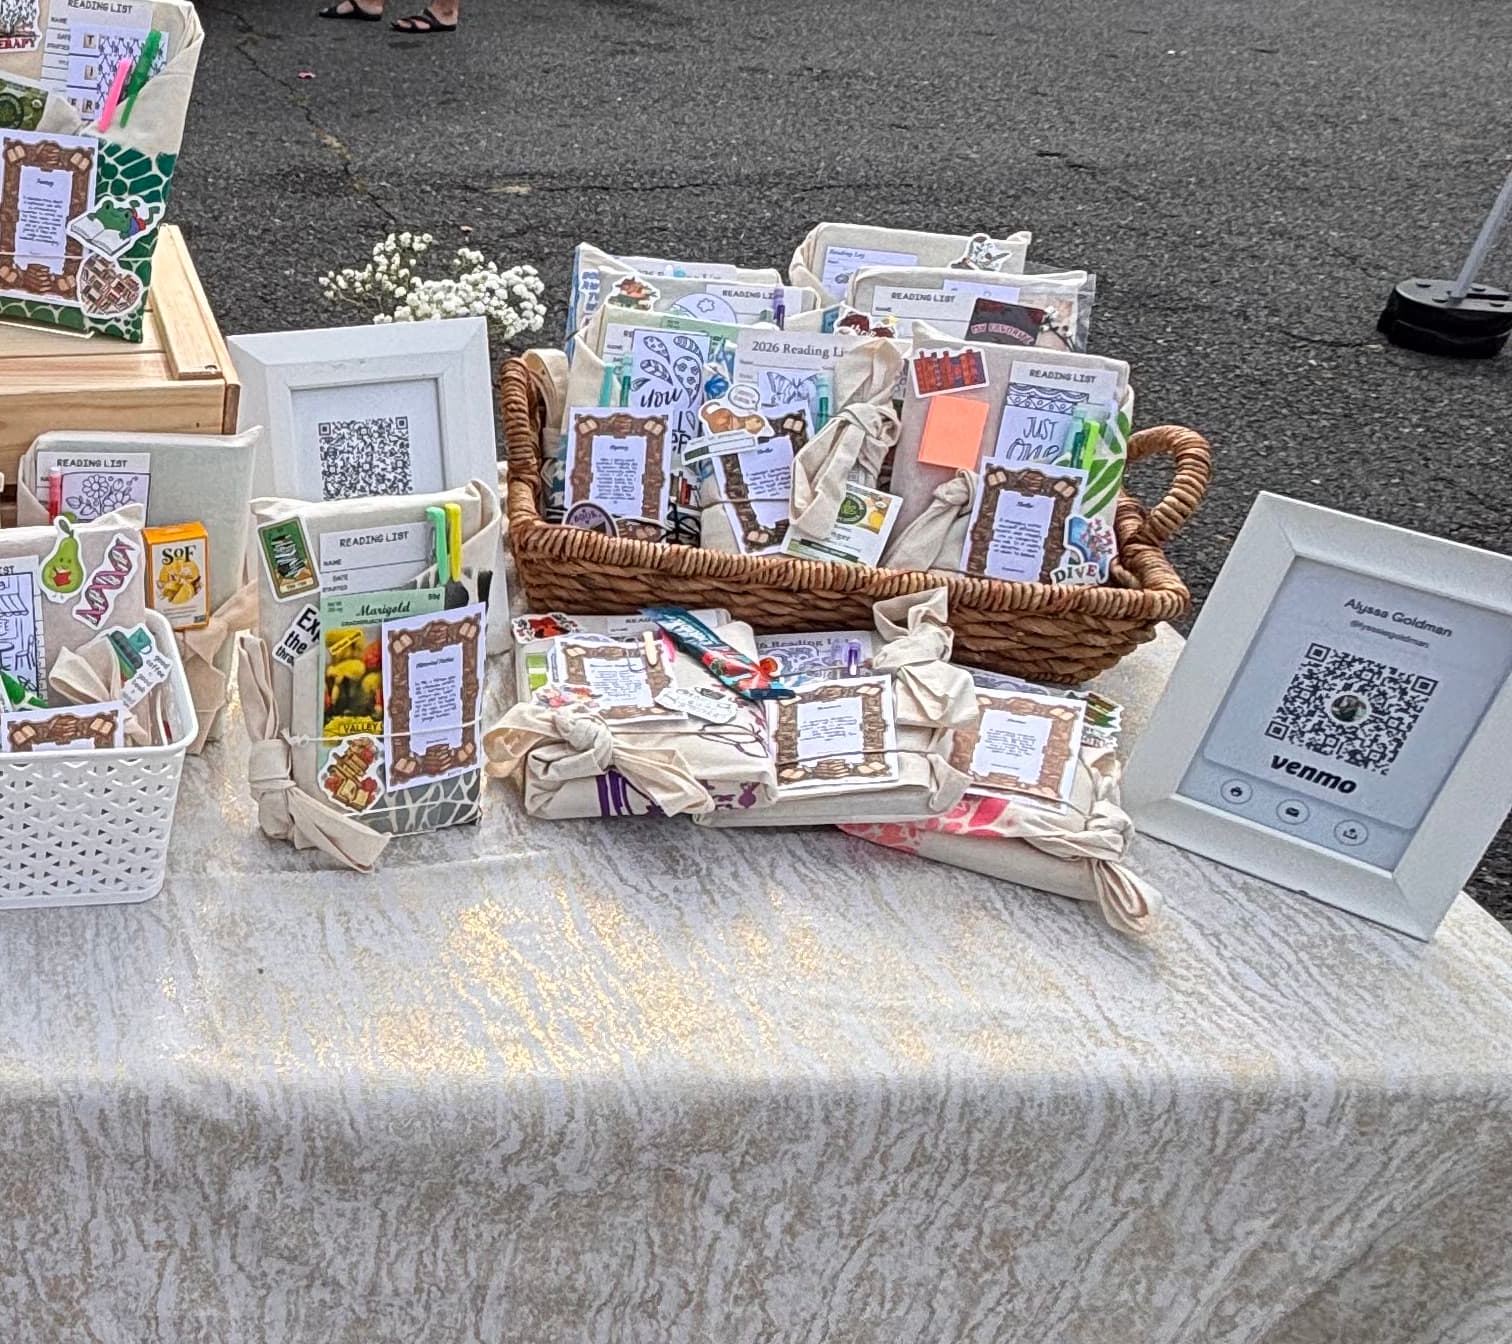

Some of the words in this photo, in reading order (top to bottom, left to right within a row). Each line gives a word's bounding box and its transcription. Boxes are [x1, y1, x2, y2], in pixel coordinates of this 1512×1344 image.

[110, 3, 134, 14] LIST
[722, 289, 761, 299] READING
[891, 292, 931, 303] READING
[933, 294, 956, 304] LIST
[752, 341, 780, 353] 2026
[783, 343, 830, 360] Reading
[1029, 369, 1072, 382] READING
[1074, 374, 1097, 384] LIST
[1023, 416, 1059, 441] JUST
[56, 458, 102, 469] READING
[103, 458, 128, 469] LIST
[339, 535, 384, 548] READING
[386, 531, 409, 542] LIST
[322, 558, 342, 567] NAME
[332, 574, 348, 583] DATE
[1054, 566, 1099, 584] DIVE
[355, 600, 411, 617] Marigold
[1344, 598, 1389, 619] Alyssa
[1391, 611, 1453, 638] Goldman
[284, 631, 308, 655] the
[343, 722, 378, 733] VALLEY
[1270, 754, 1357, 794] venmo
